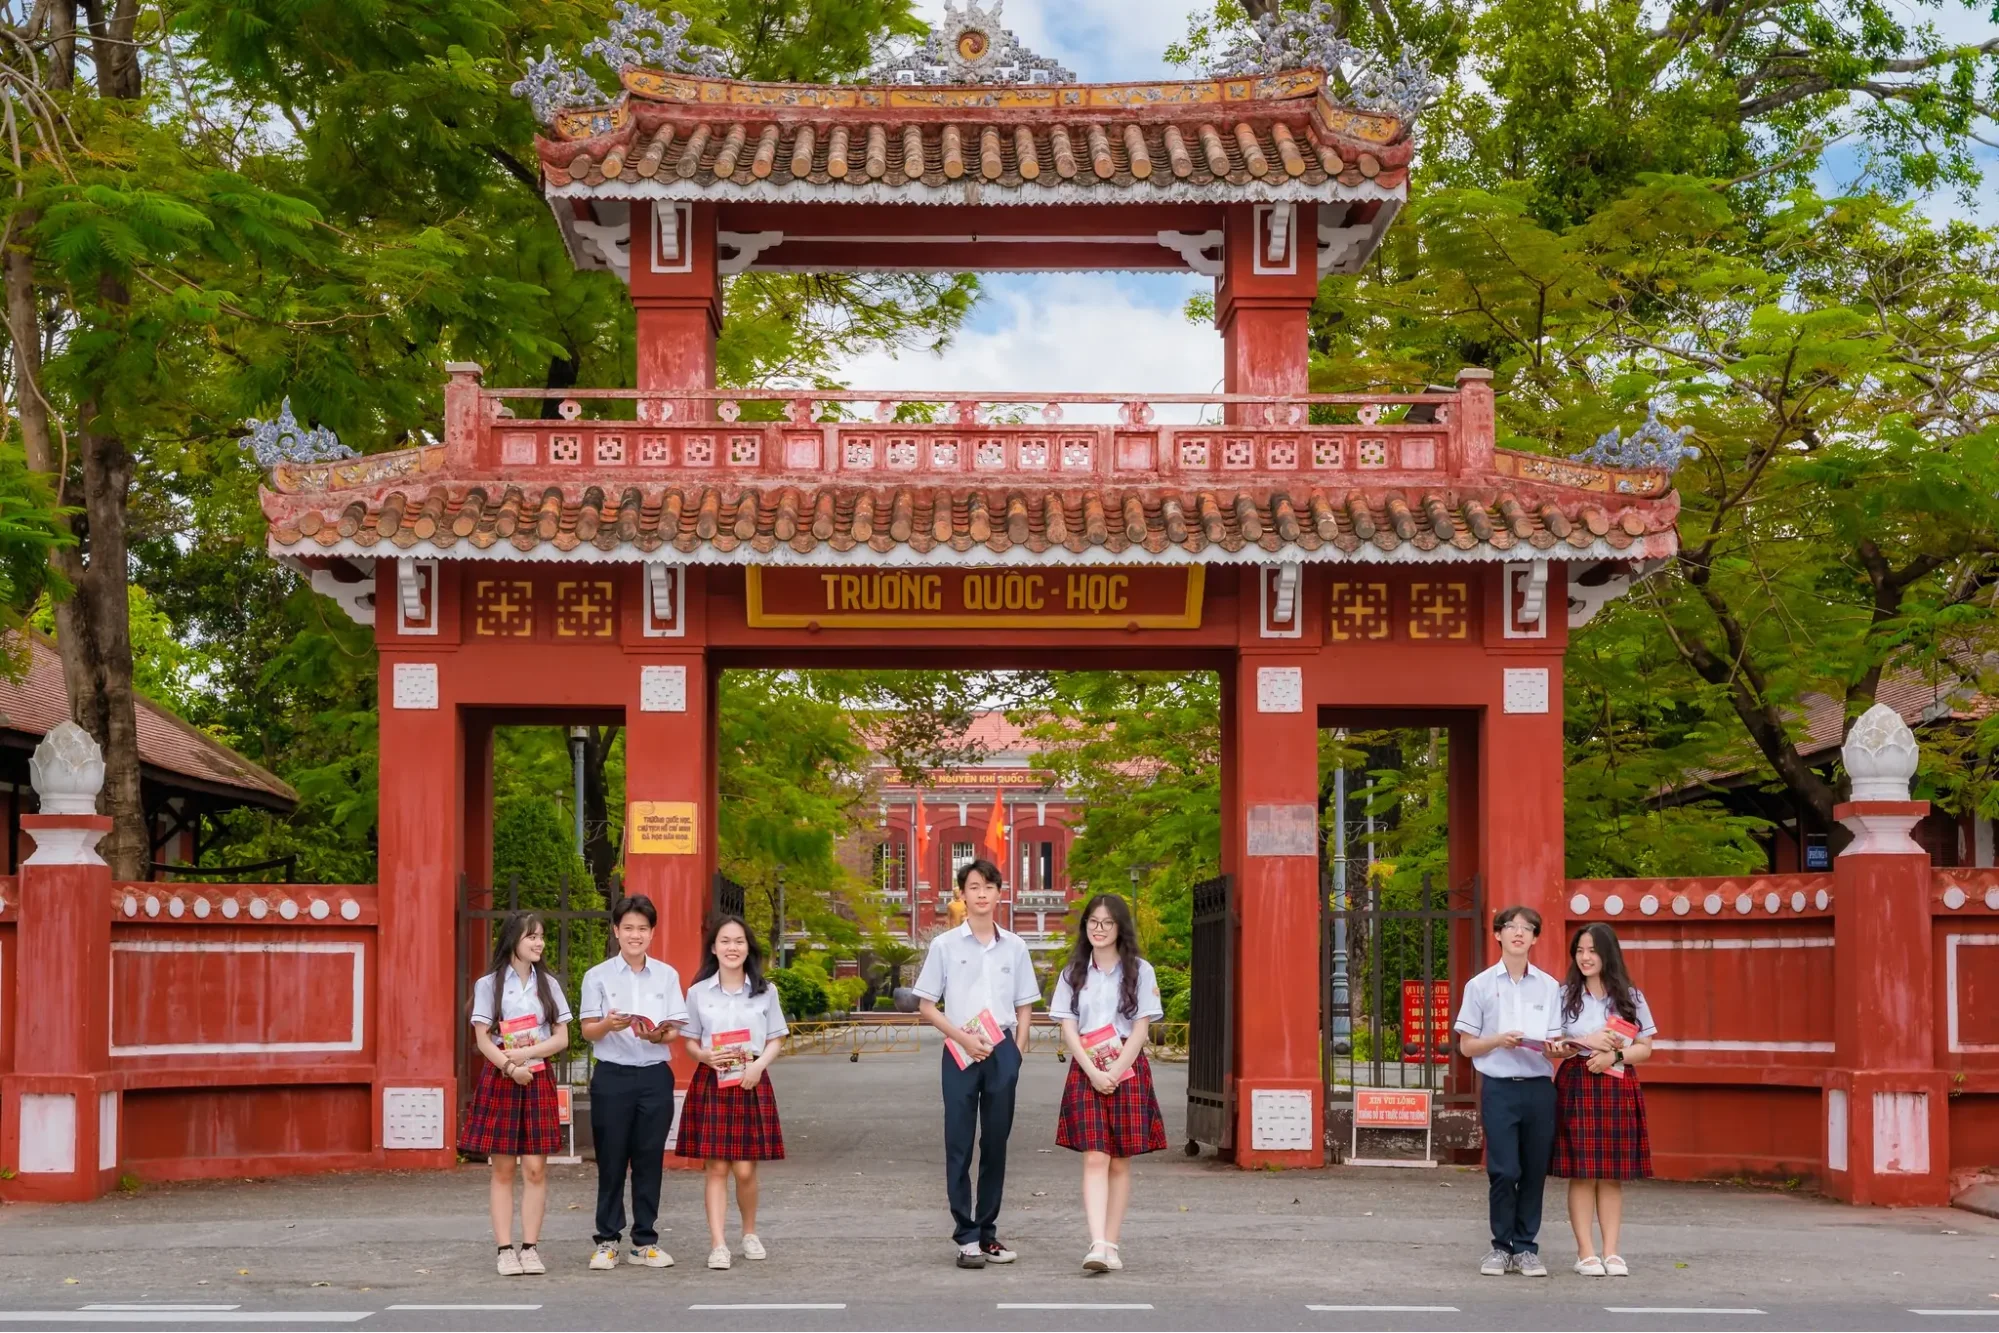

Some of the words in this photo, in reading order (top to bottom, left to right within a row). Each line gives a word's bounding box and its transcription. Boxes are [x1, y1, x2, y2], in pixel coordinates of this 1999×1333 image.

[963, 570, 1044, 610] QUỐC
[1066, 574, 1129, 615] HỌC
[939, 772, 977, 783] NGUYÊN
[979, 772, 996, 783] KHÍ
[997, 772, 1024, 784] QUỐC
[1383, 1096, 1396, 1105] VUI
